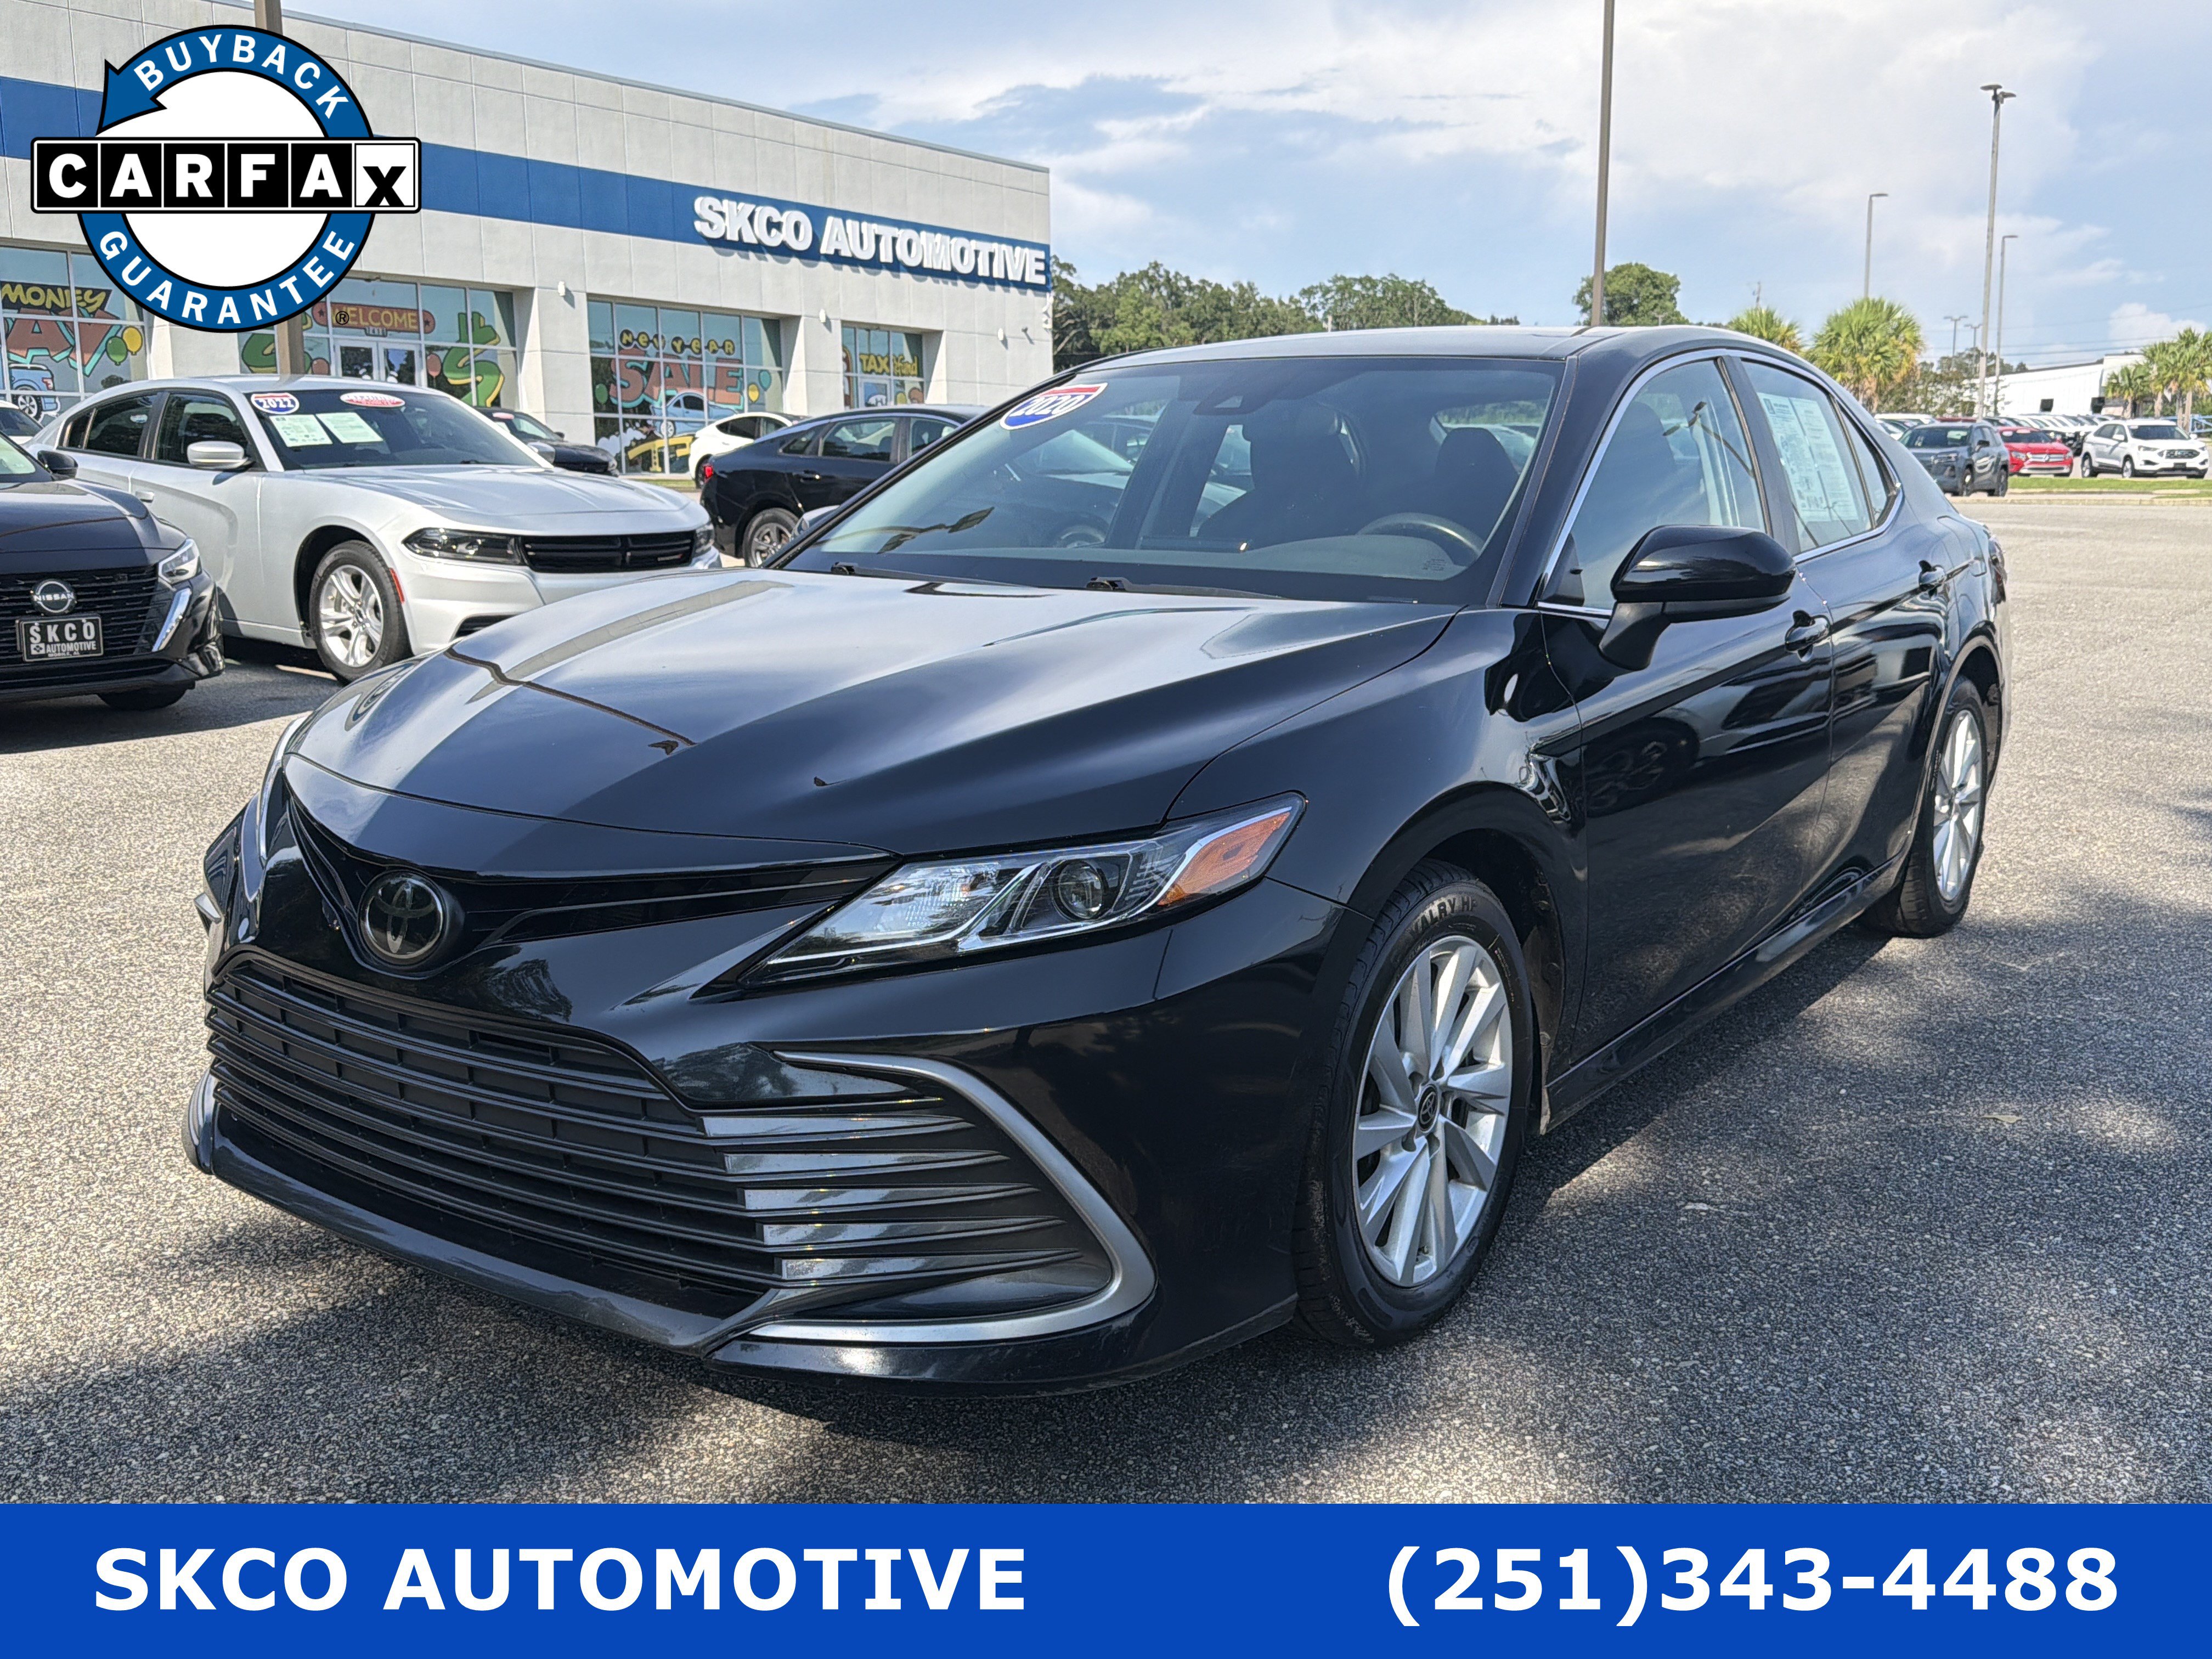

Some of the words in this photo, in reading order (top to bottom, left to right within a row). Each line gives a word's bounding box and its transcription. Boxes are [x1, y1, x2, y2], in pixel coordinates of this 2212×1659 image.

[694, 196, 812, 251] SKCO
[820, 216, 1046, 284] AUTOMOTIVE
[1, 283, 106, 313] MONEY
[331, 307, 418, 329] WELCOME
[860, 354, 890, 374] TAX
[610, 346, 743, 408] SALE
[261, 398, 295, 409] 2022
[1009, 394, 1085, 416] 2020
[33, 591, 75, 602] NISSAN
[30, 622, 95, 644] SKCO
[47, 641, 97, 653] AUTOMOTIVE
